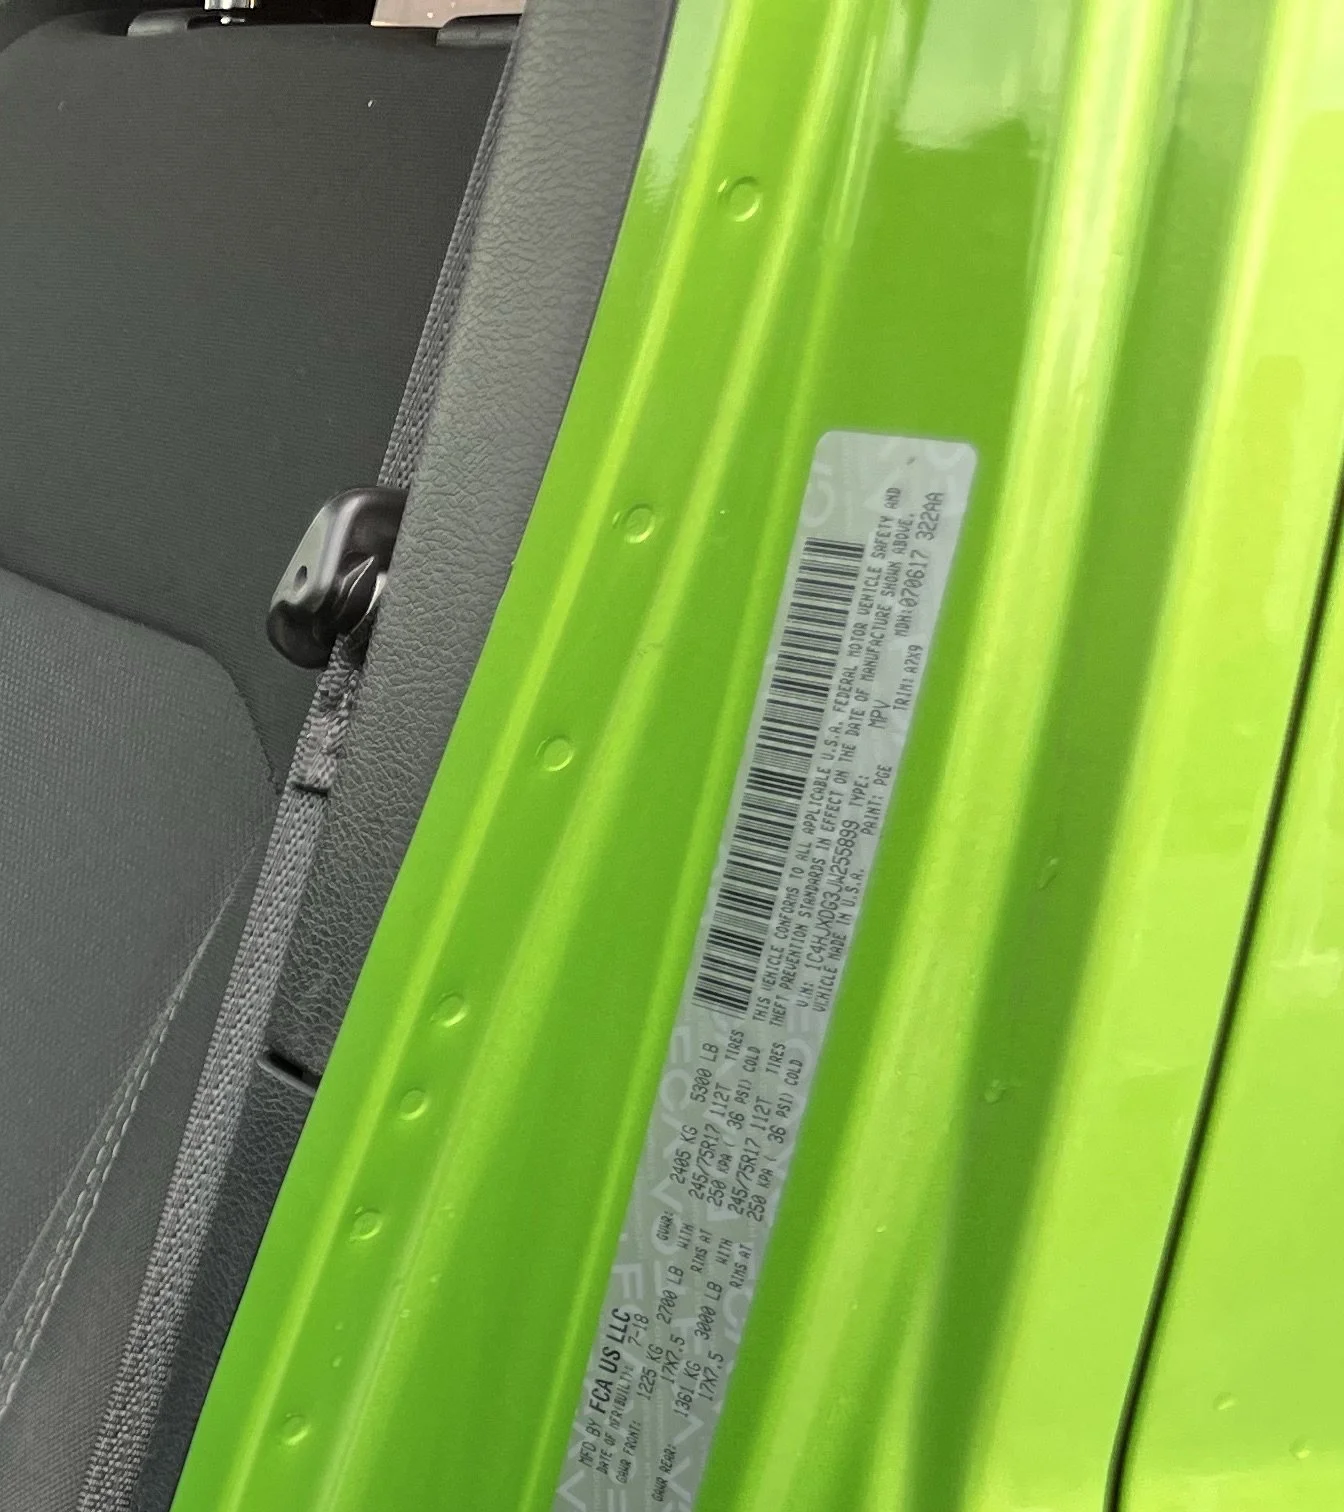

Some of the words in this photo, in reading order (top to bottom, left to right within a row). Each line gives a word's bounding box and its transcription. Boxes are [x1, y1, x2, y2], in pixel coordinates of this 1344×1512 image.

[881, 486, 903, 509] AND
[869, 515, 896, 559] SAFETY
[890, 512, 916, 555] ABOVE.
[855, 566, 882, 615] VEHICLE
[880, 560, 903, 597] SHOWN
[844, 621, 868, 657] MOTOR
[858, 603, 892, 682] MANUFACTURE
[902, 643, 924, 674] A7X9
[830, 663, 857, 713] FEDERAL
[853, 687, 870, 702] OF
[892, 676, 916, 711] TRIM:
[803, 818, 860, 971] 1C4HJXDG3JW255899
[848, 773, 870, 807] TYPE:
[867, 698, 891, 728] MPV
[915, 491, 945, 540] 322AA
[844, 708, 865, 736] DATE
[819, 719, 844, 760] U.S.A.
[837, 743, 855, 764] THE
[831, 768, 849, 784] ON
[872, 763, 892, 786] PGE
[799, 765, 830, 835] APPLICABLE
[819, 789, 843, 832] EFFECT
[859, 793, 884, 835] PAINT:
[793, 839, 811, 861] ALL
[814, 835, 831, 851] IN
[788, 865, 804, 880] TO
[796, 856, 825, 918] STANDARDS
[840, 865, 864, 907] U.S.A.
[773, 885, 799, 940] CONFORMS
[835, 911, 852, 926] IN
[778, 922, 808, 990] PREVENTION
[826, 931, 846, 961] MADE
[760, 944, 784, 992] VEHICLE
[812, 964, 838, 1013] VEHICLE
[752, 995, 771, 1023] THIS
[768, 993, 790, 1028] THEFT
[699, 1041, 719, 1062] LB
[724, 1027, 745, 1062] TIRES
[741, 1044, 761, 1073] COLD
[764, 1040, 786, 1076] TIRES
[689, 1066, 713, 1103] 5300
[782, 1056, 803, 1087] COLD
[709, 1081, 732, 1117] 112T
[748, 1094, 772, 1132] 112T
[679, 1123, 698, 1145] KG
[726, 1109, 745, 1130] 36
[766, 1123, 786, 1145] 36
[669, 1147, 692, 1185] 2405
[687, 1122, 721, 1200] 245/75R17
[715, 1150, 733, 1175] KPA
[726, 1136, 761, 1215] 245/75R17
[755, 1164, 774, 1189] KPA
[706, 1178, 727, 1207] 250
[745, 1192, 767, 1223] 250
[675, 1220, 695, 1250] WITH
[697, 1227, 713, 1244] AT
[714, 1236, 733, 1265] WITH
[736, 1242, 753, 1260] AT
[665, 1264, 684, 1285] LB
[690, 1245, 708, 1274] RIMS
[728, 1260, 748, 1290] RIMS
[655, 1287, 678, 1324] 2700
[703, 1279, 722, 1300] LB
[605, 1306, 631, 1344] LLC
[627, 1311, 649, 1348] 7-18
[693, 1303, 716, 1341] 3000
[597, 1343, 621, 1375] US
[645, 1342, 663, 1363] KG
[659, 1333, 685, 1384] 17X7.5
[636, 1365, 657, 1401] 1225
[683, 1358, 701, 1380] KG
[697, 1349, 724, 1402] 17X7.5
[588, 1374, 613, 1414] FCA
[673, 1383, 695, 1418] 1361
[585, 1417, 602, 1437] BY
[603, 1431, 616, 1447] OF
[622, 1417, 641, 1456] FRONT:
[577, 1439, 597, 1468] MFD
[596, 1448, 612, 1475] DATE
[658, 1442, 677, 1474] REAR:
